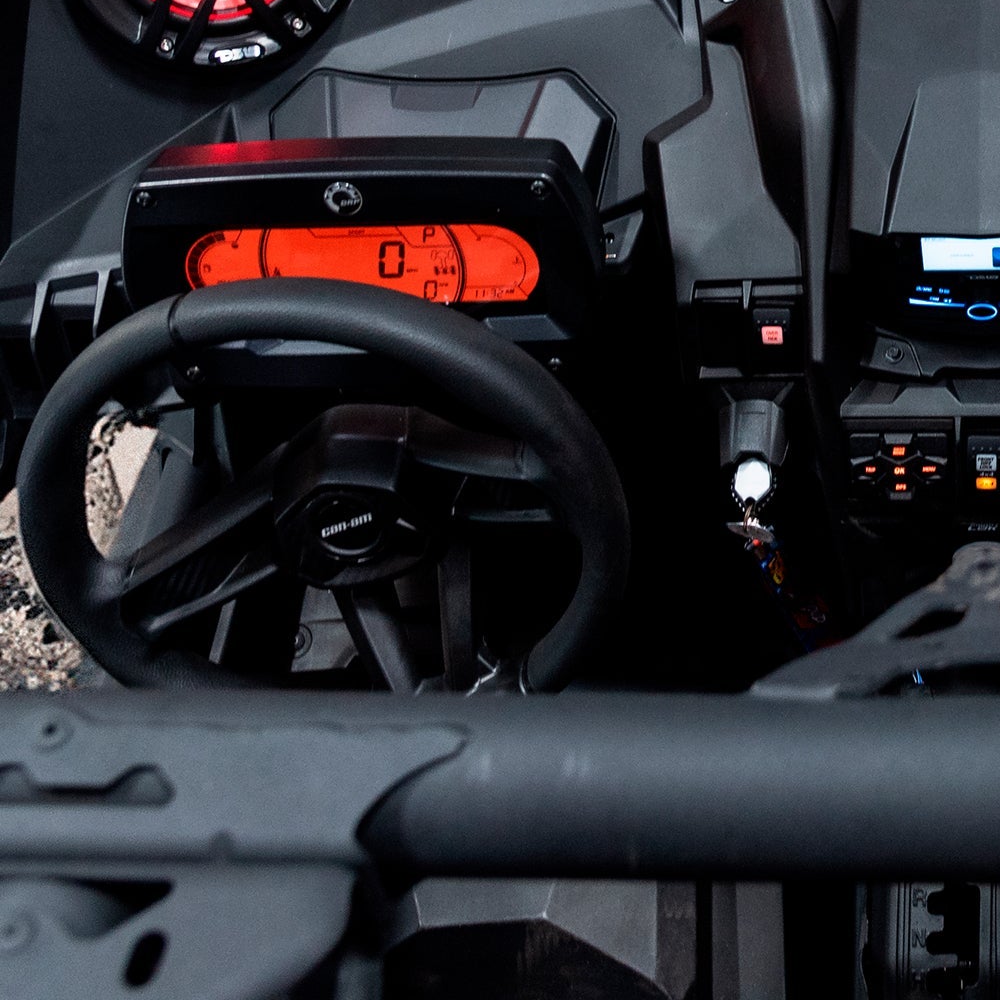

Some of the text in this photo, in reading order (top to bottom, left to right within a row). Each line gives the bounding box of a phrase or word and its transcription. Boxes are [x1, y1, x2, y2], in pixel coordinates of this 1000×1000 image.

[423, 225, 436, 244] P
[378, 240, 406, 280] 0
[423, 280, 438, 300] 0
[912, 887, 927, 907] R
[911, 927, 926, 948] N
